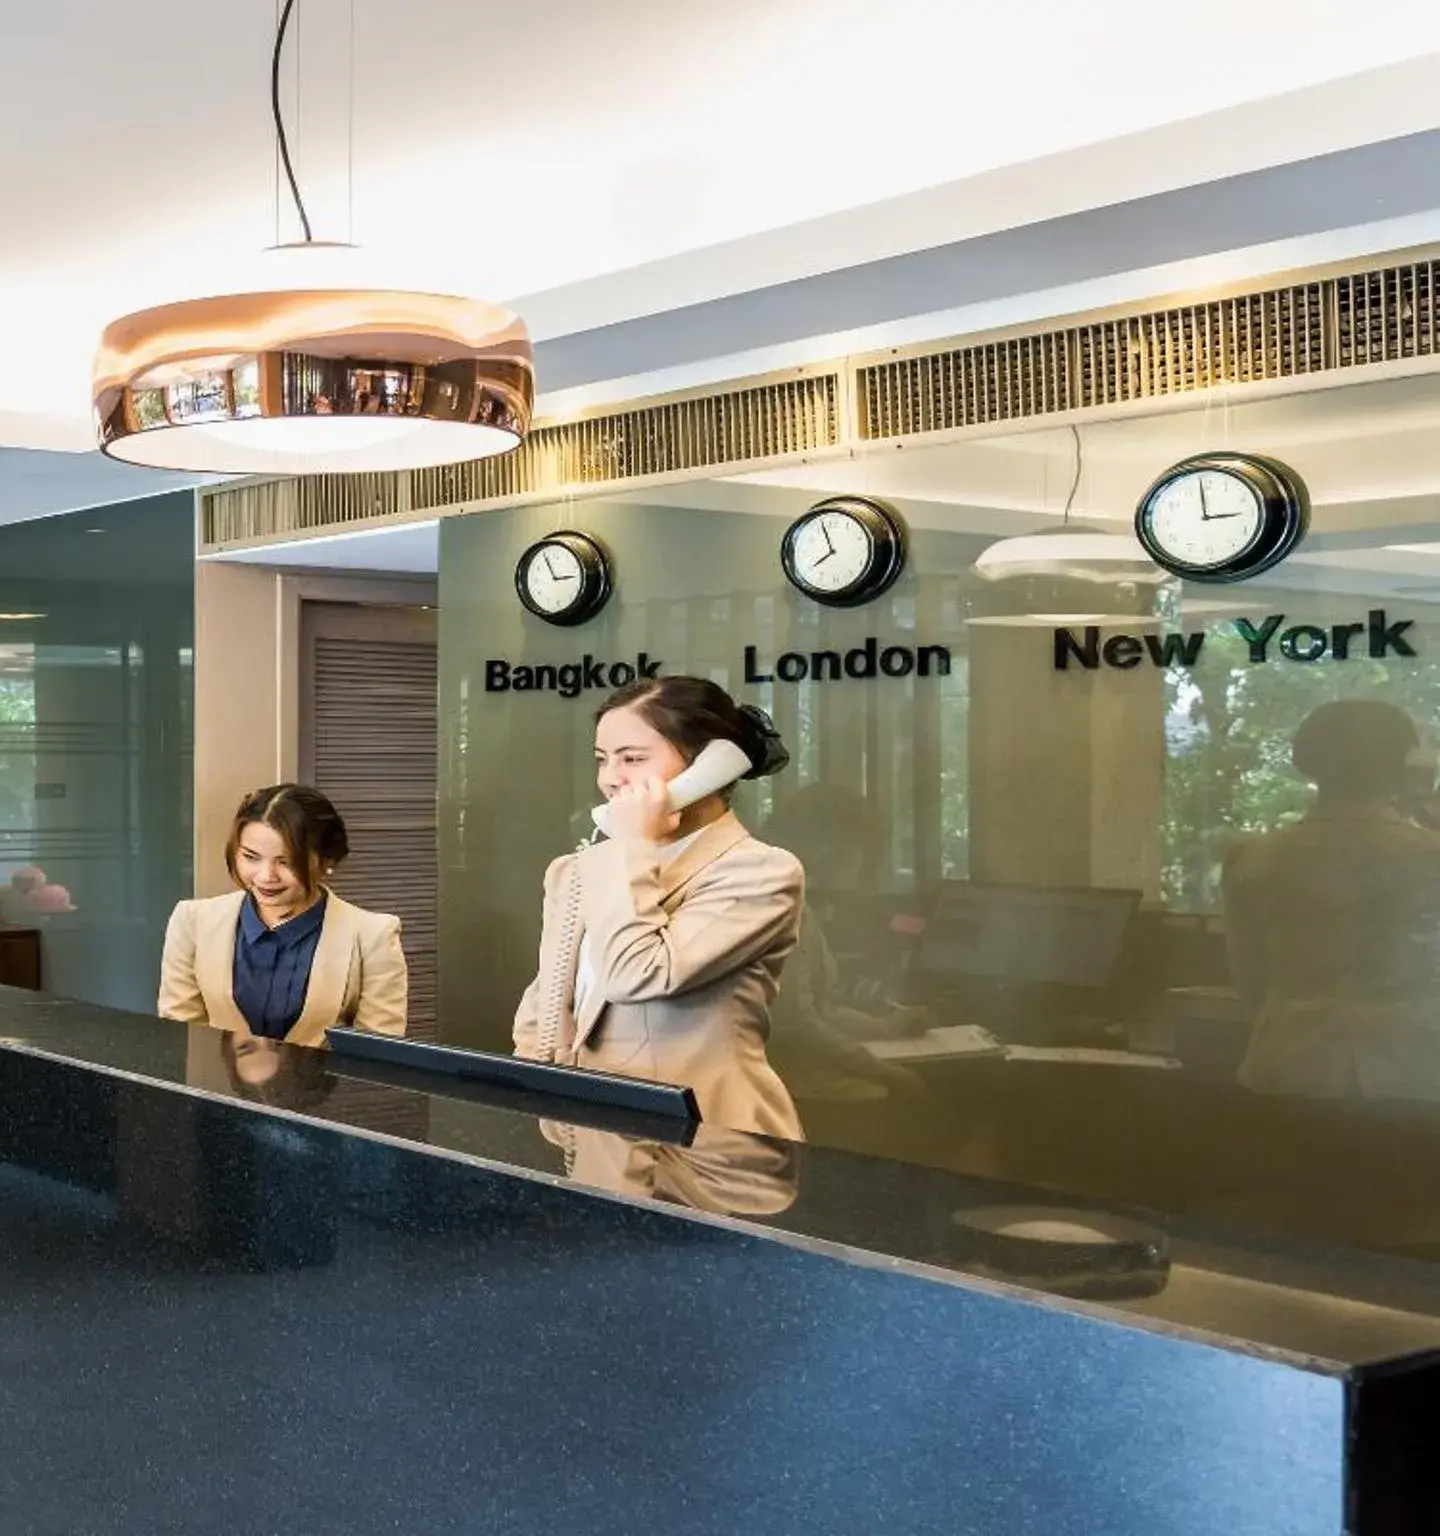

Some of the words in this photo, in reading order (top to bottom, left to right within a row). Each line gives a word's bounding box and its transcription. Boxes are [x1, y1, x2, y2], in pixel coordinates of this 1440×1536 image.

[744, 637, 952, 683] London
[1053, 625, 1205, 670] New
[1235, 609, 1418, 663] York
[485, 652, 662, 698] Bangkok
